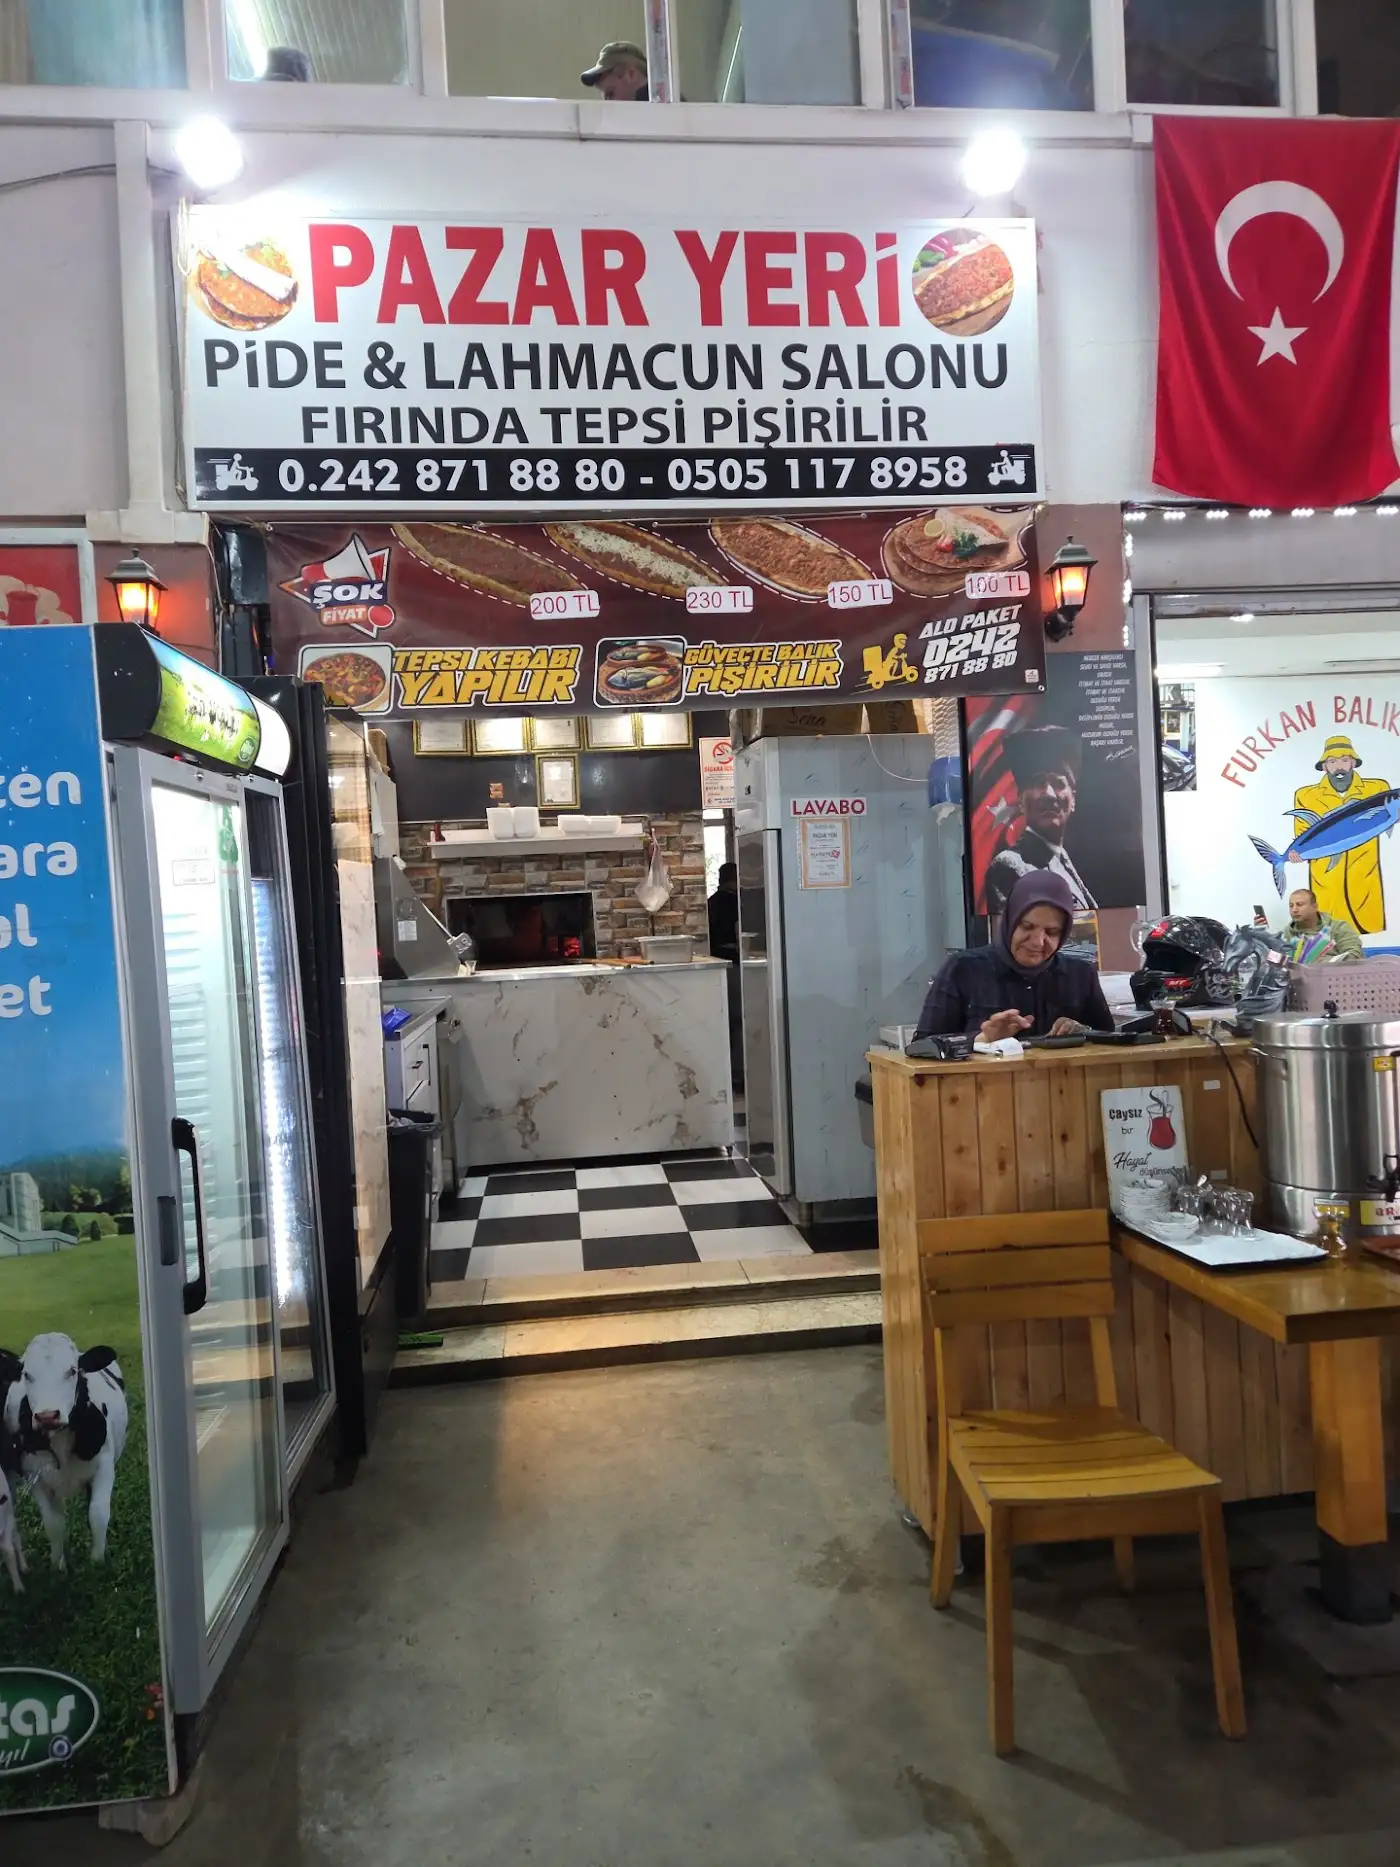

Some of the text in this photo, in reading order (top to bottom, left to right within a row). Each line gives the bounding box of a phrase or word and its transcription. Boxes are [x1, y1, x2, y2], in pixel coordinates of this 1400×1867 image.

[308, 223, 650, 326] PAZAR
[363, 341, 407, 390] &
[424, 342, 763, 391] LAHMACUN
[782, 343, 1008, 391] SALONU
[302, 397, 928, 448] FIRINDA TEPSİ PİŞİRİLİR
[278, 458, 400, 492] 0.242
[416, 458, 487, 492] 871
[509, 458, 560, 492] 88
[575, 458, 626, 492] 80
[667, 458, 767, 491] 0505
[785, 457, 856, 490] 117
[870, 455, 968, 488] 8958
[313, 583, 383, 609] ŞOK
[687, 590, 753, 609] 230 TL
[829, 583, 892, 603] 150 TL
[967, 575, 1029, 594] 100 TL
[323, 607, 367, 625] FİYAT
[531, 595, 599, 615] 200 TL
[918, 603, 1023, 640] ALO PAKET
[684, 641, 840, 667] GÜVEÇTE BALIK
[922, 622, 1021, 669] 0242
[687, 658, 841, 694] PİŞİRİLİR
[923, 650, 1018, 684] 871 88 80
[400, 669, 578, 706] YAPILIR
[1220, 695, 1400, 788] FURKAN BALIK
[0, 771, 81, 809] en
[793, 799, 865, 816] LAVABO
